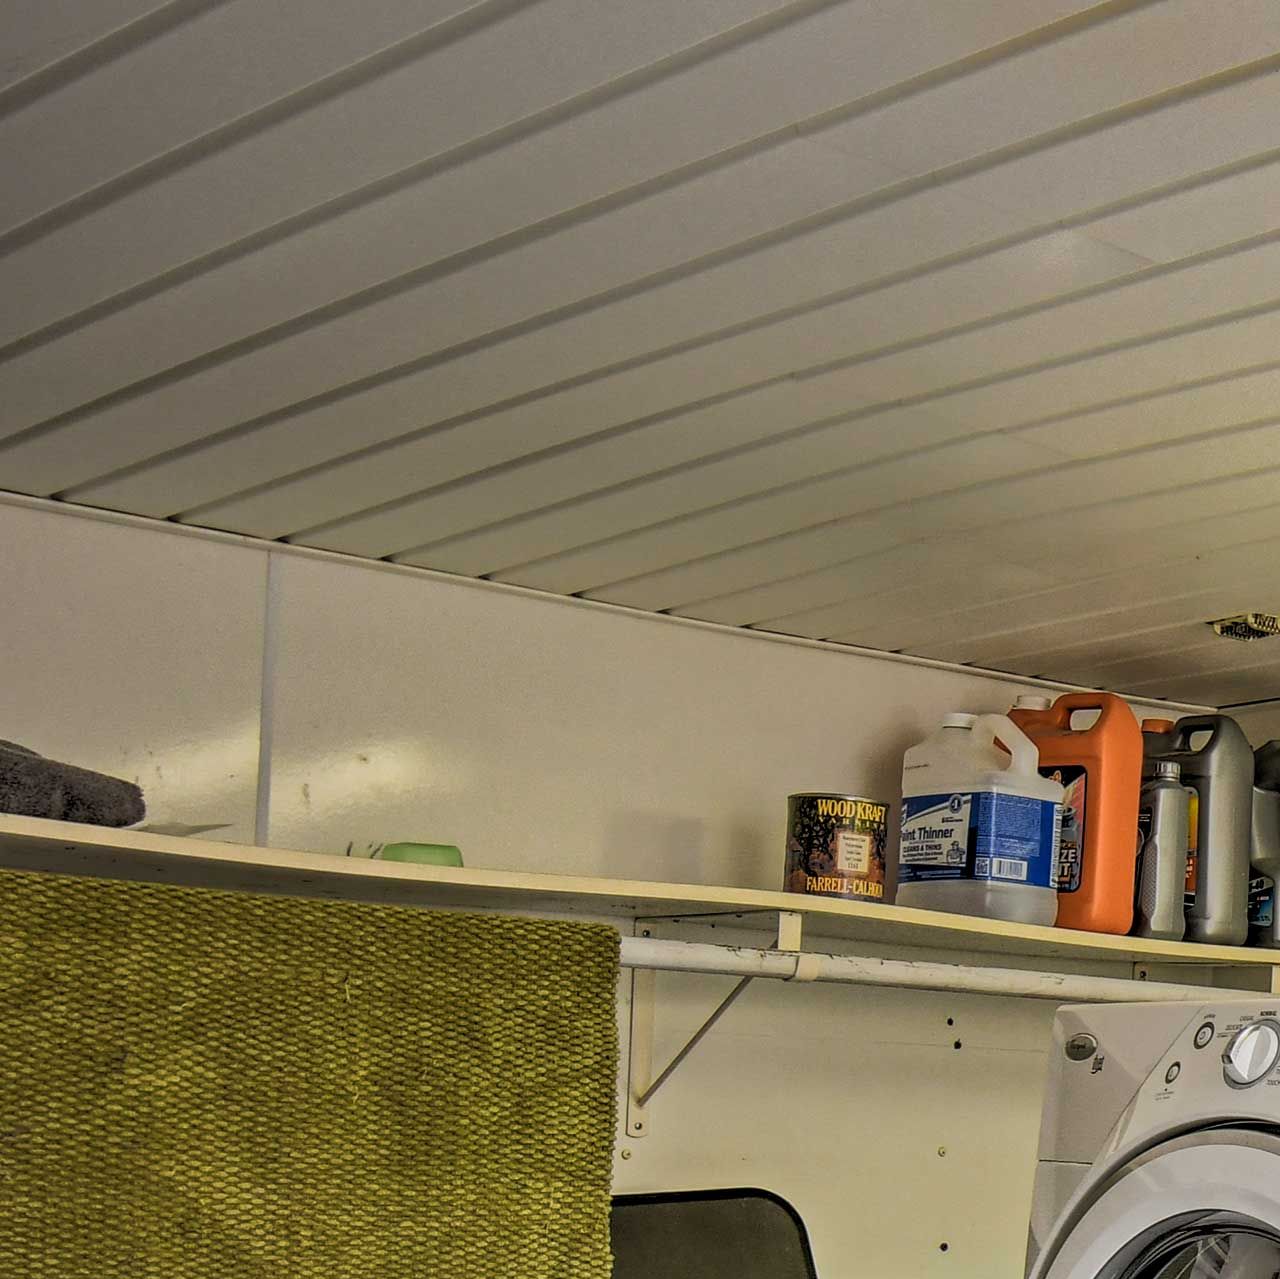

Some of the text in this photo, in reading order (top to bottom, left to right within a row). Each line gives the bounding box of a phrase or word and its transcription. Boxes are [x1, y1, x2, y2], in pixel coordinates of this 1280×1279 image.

[817, 799, 886, 823] WOOD KRAFT
[899, 828, 916, 842] aint
[917, 826, 955, 840] Thinner
